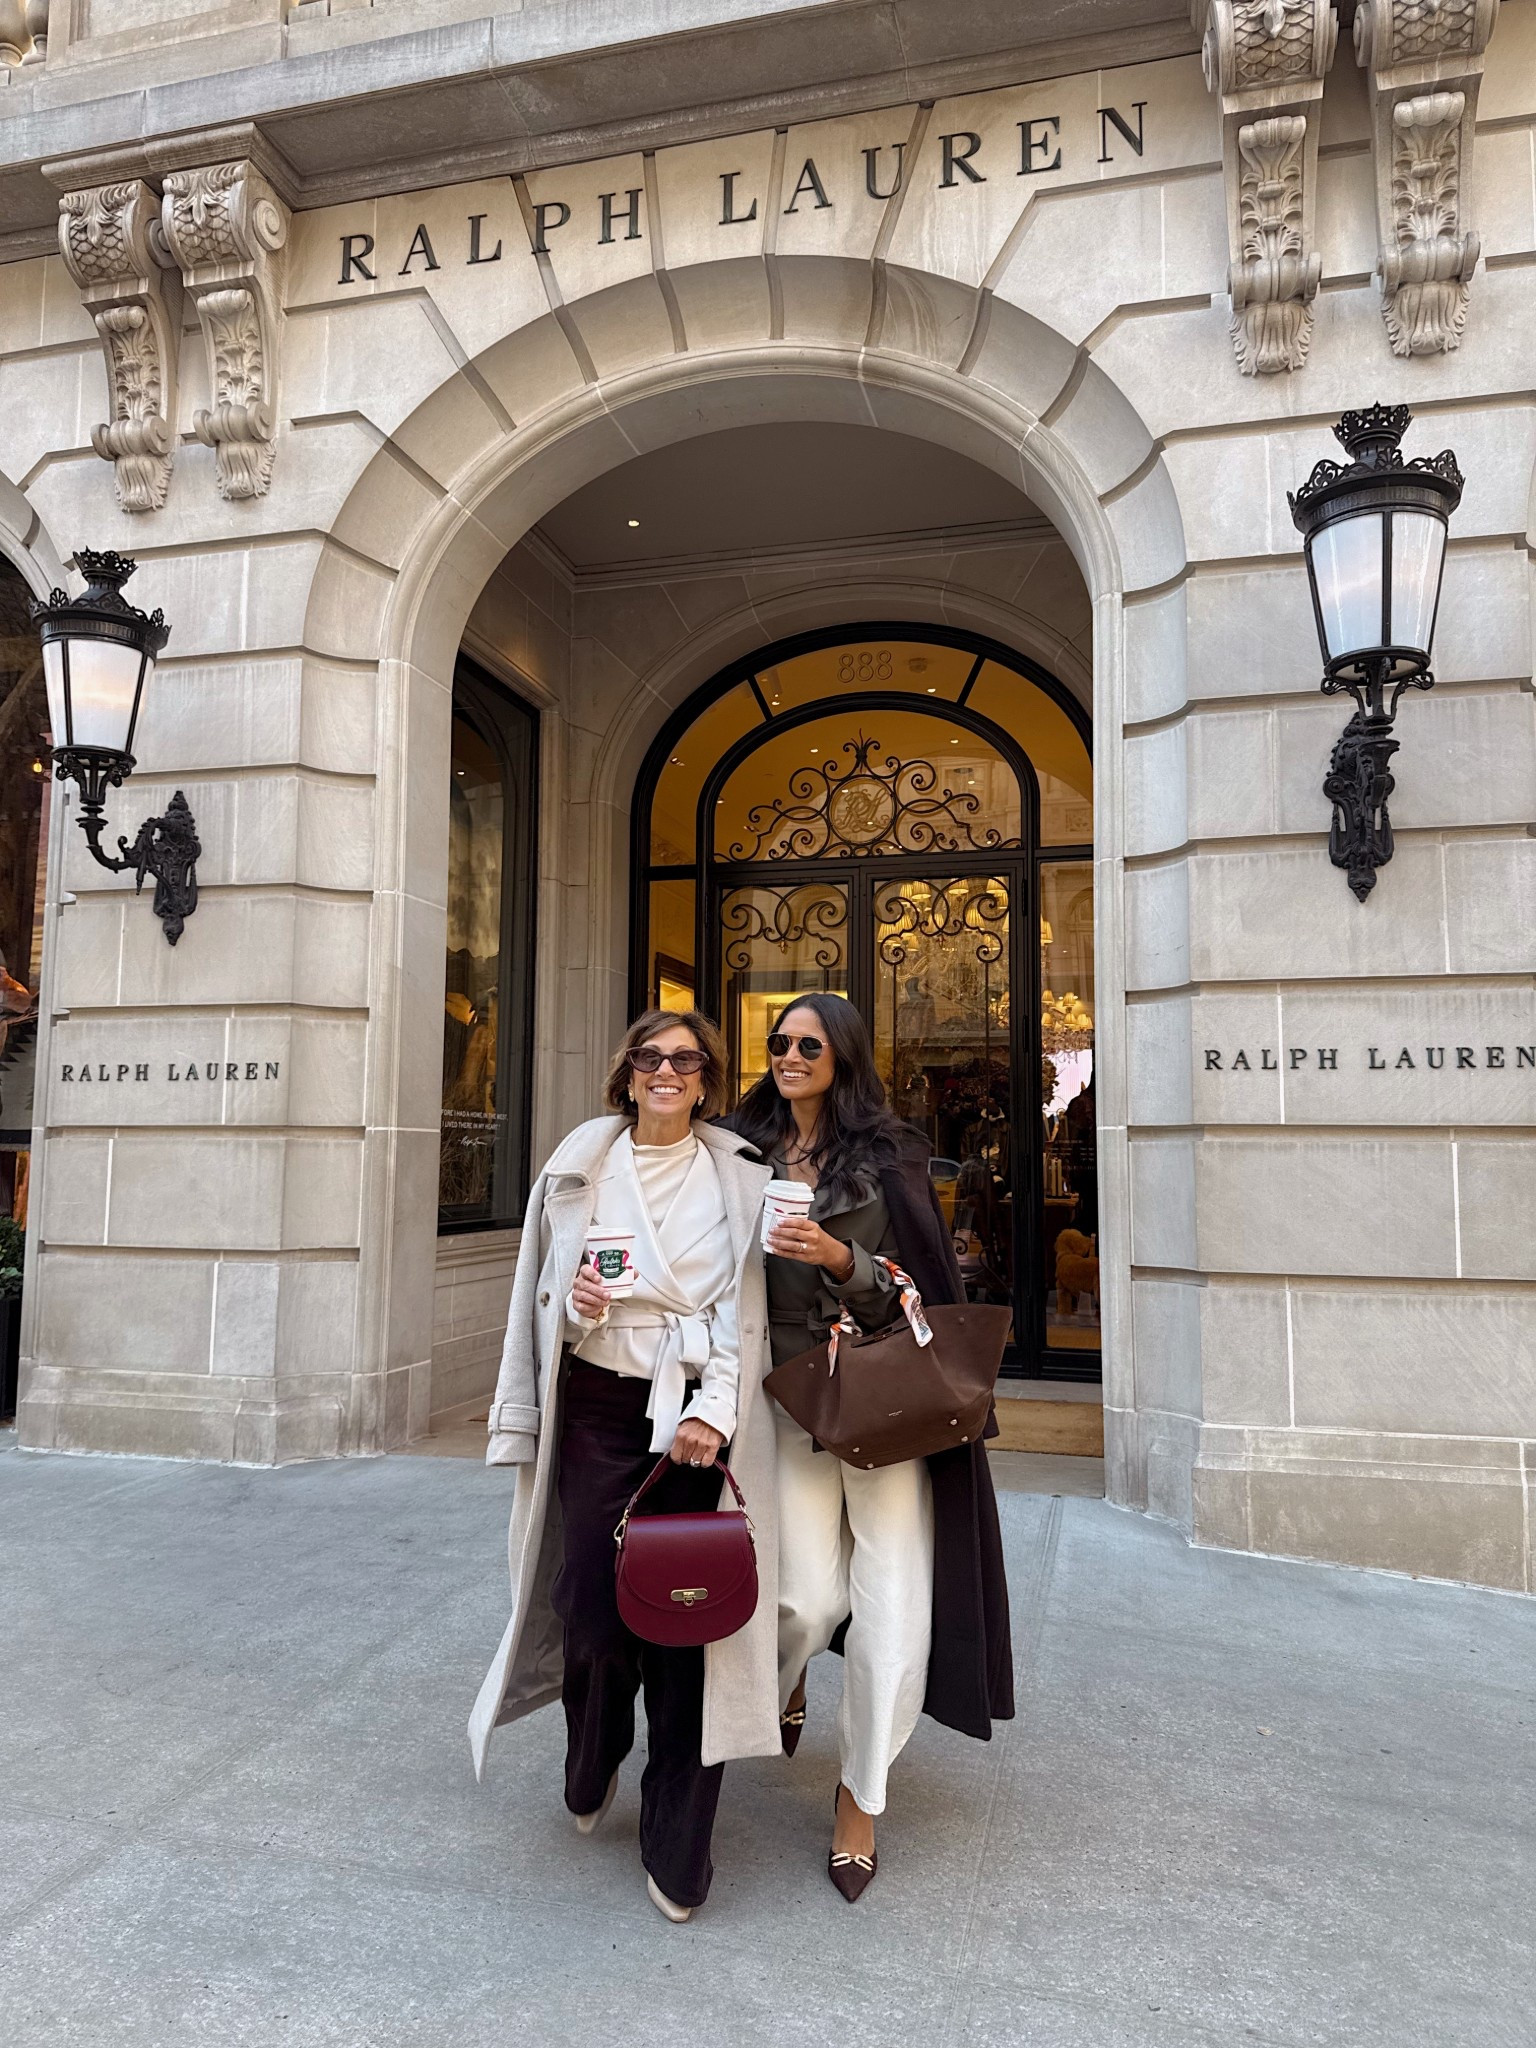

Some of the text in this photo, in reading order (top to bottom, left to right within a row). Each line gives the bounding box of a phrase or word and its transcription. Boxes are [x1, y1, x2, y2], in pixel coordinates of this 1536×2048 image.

[337, 101, 1148, 284] RALPH LAUREN
[837, 650, 893, 683] 888
[61, 1062, 280, 1082] RALPH LAUREN
[1204, 1046, 1536, 1070] RALPH LAUREN
